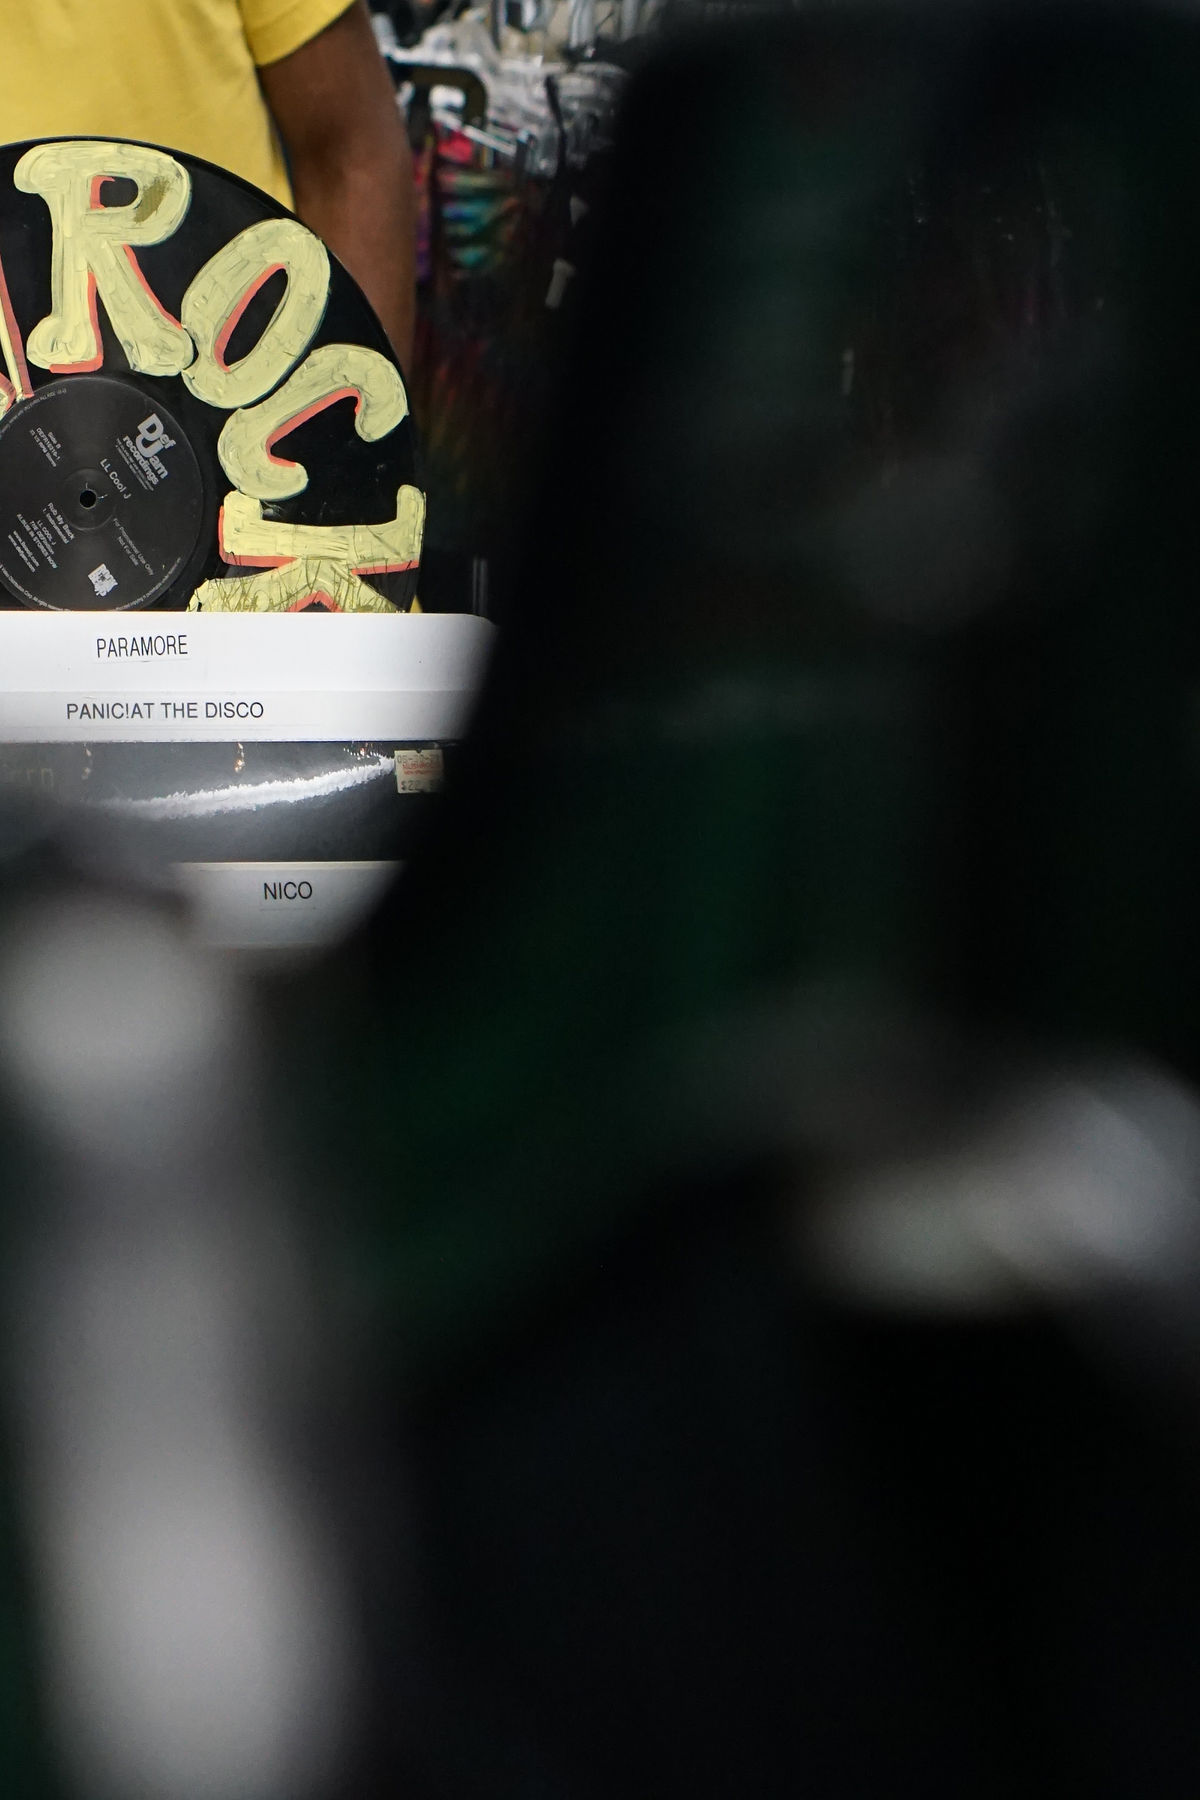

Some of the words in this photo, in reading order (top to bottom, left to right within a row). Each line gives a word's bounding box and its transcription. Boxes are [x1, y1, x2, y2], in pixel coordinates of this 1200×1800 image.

[137, 413, 176, 449] Def
[123, 435, 159, 485] recordings
[100, 458, 111, 473] LL
[109, 471, 127, 493] Cool
[96, 634, 189, 658] PARAMORE
[160, 702, 198, 719] THE
[204, 701, 264, 719] DISCO
[263, 881, 313, 900] NICO
